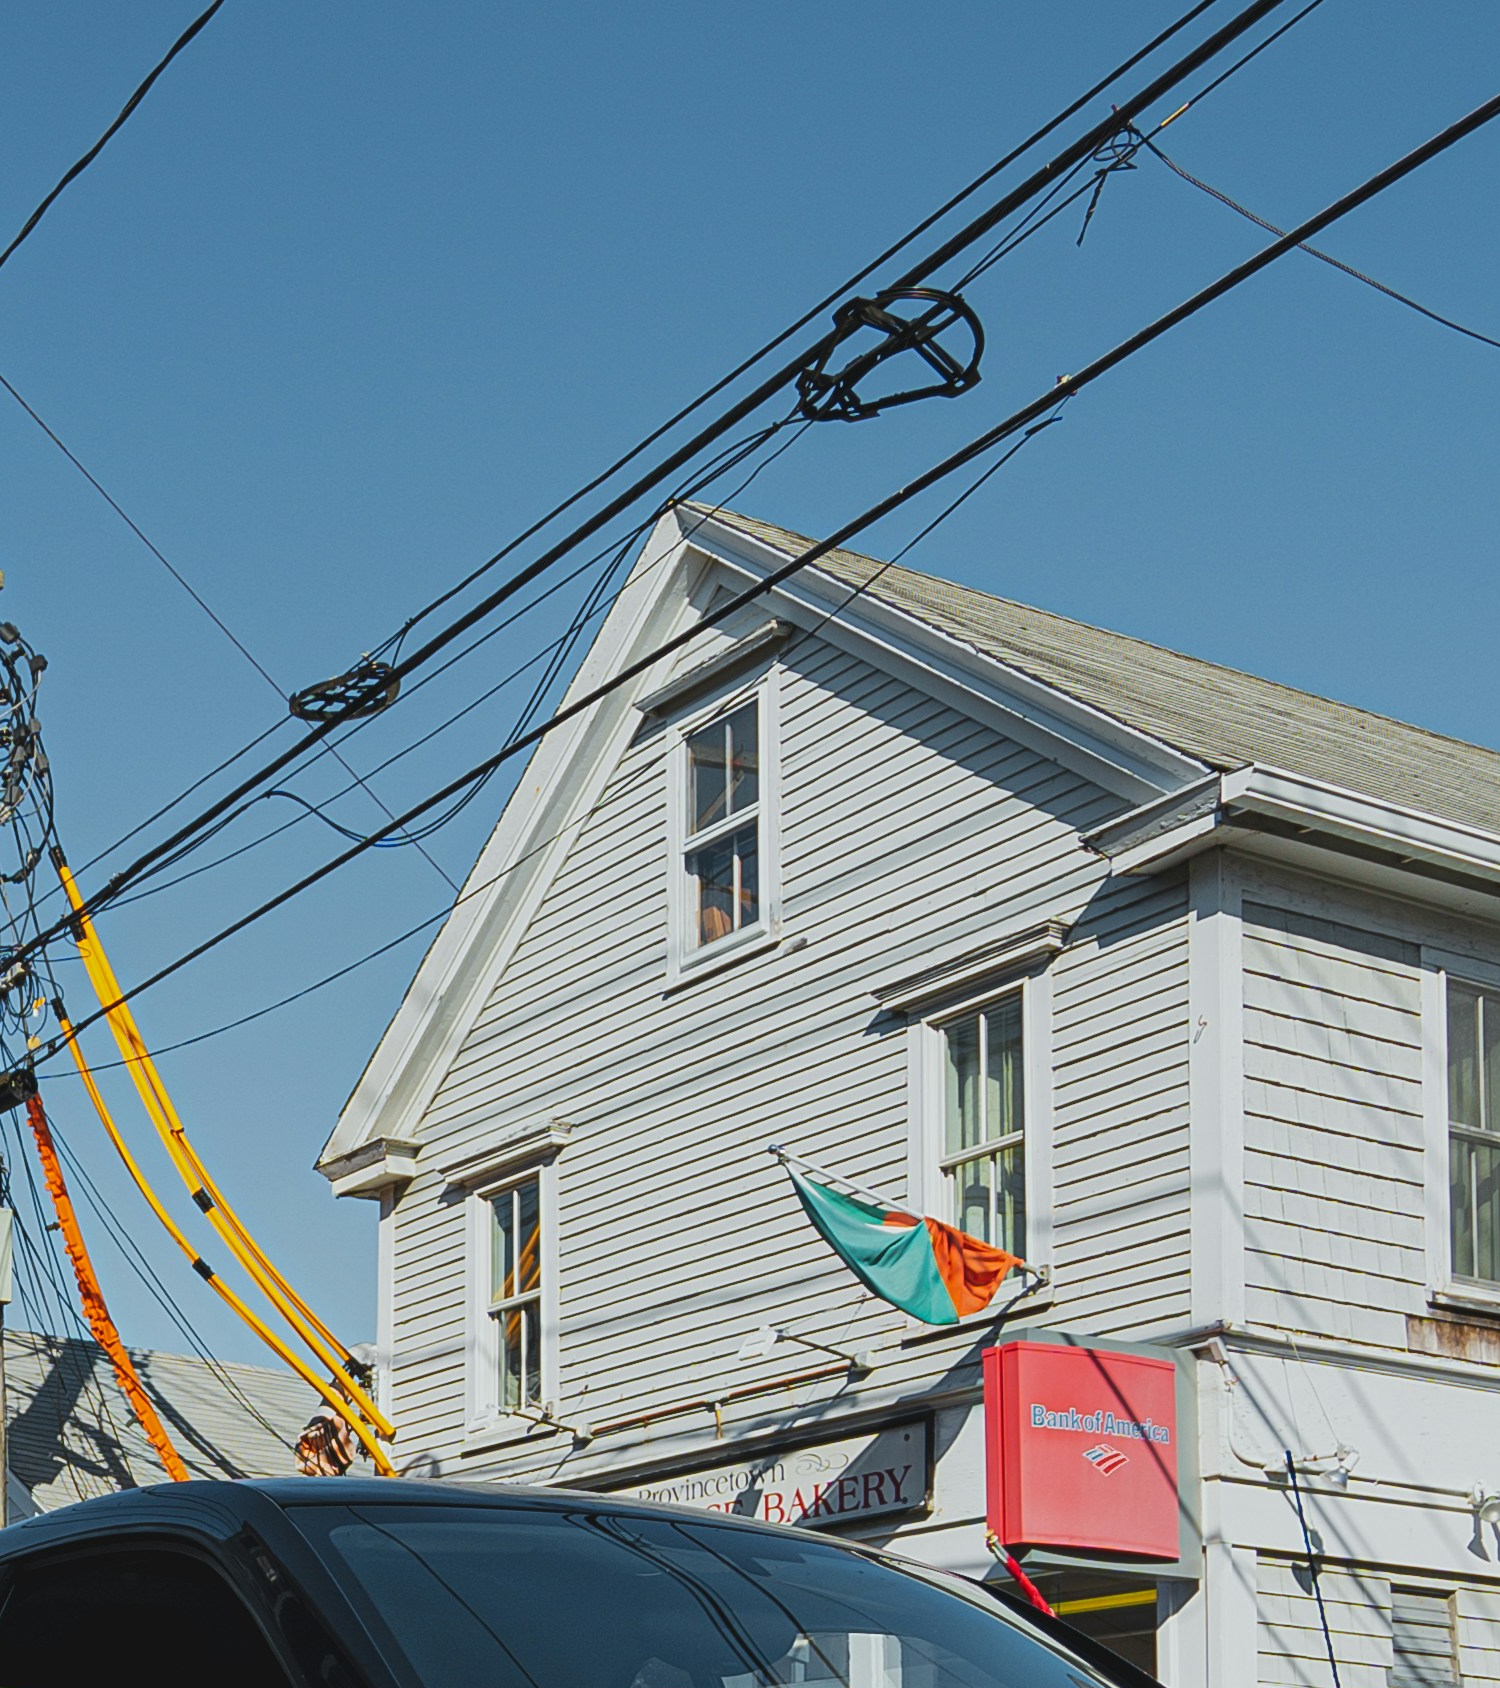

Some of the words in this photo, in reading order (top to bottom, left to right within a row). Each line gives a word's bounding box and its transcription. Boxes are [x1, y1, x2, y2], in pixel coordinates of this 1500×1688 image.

[1031, 1404, 1082, 1431] Bank
[1084, 1410, 1102, 1432] of
[1104, 1412, 1170, 1444] America
[639, 1461, 785, 1504] Provincetown
[763, 1464, 913, 1525] BAKERY
